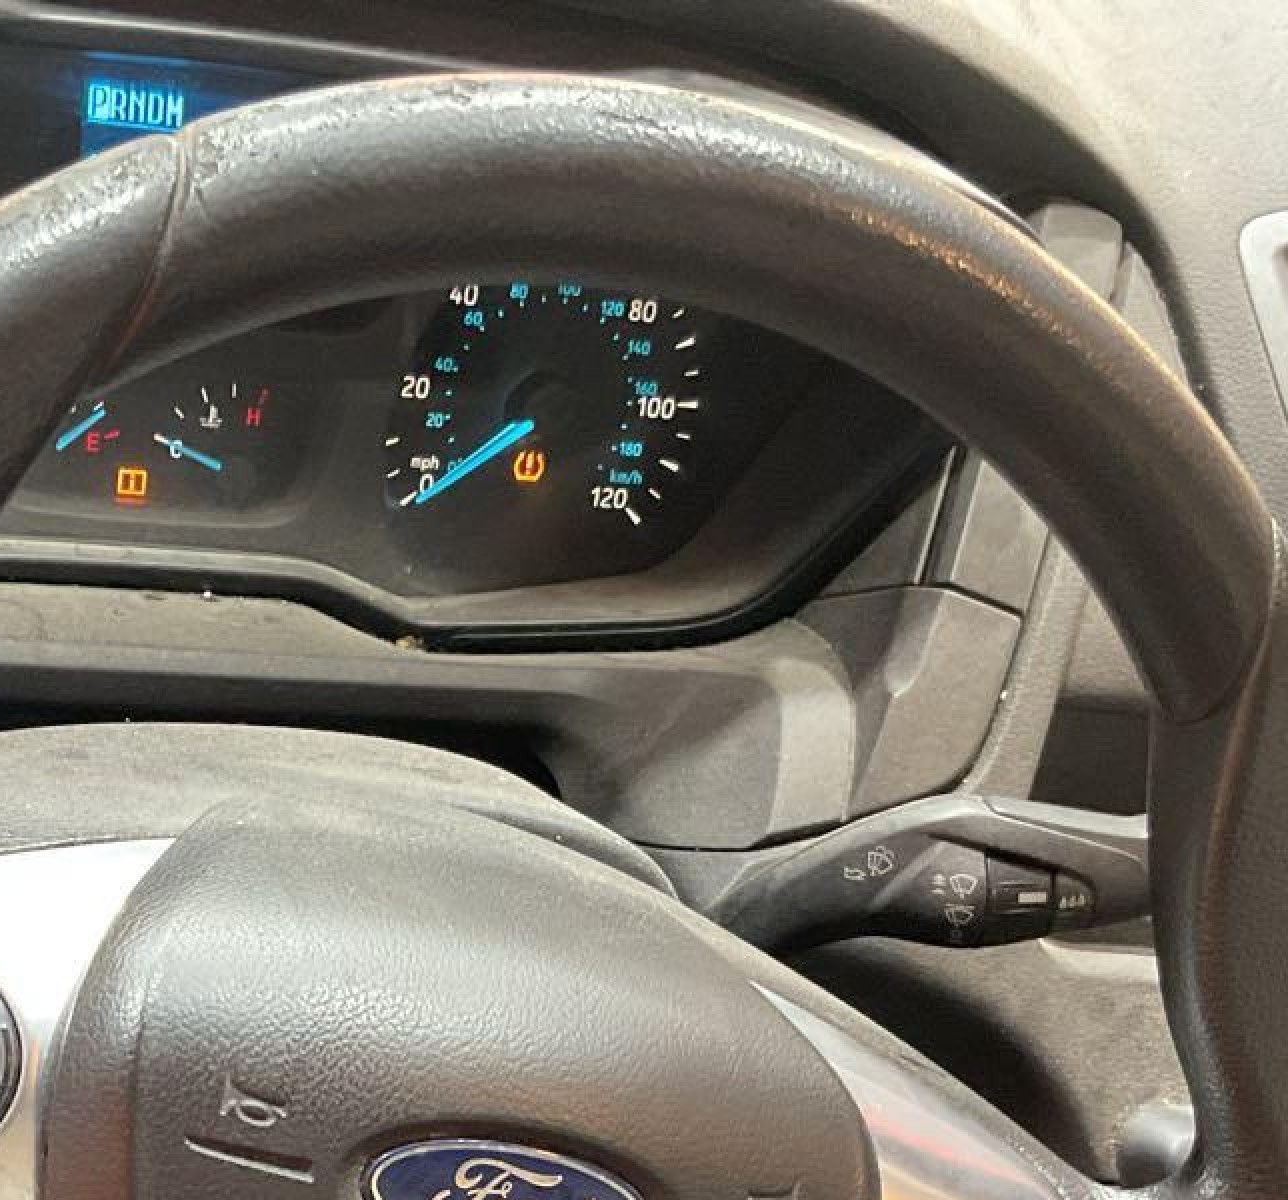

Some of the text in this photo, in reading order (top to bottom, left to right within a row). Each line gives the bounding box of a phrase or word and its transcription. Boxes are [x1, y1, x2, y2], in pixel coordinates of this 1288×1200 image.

[449, 283, 479, 307] 40
[601, 300, 625, 317] 120
[628, 299, 657, 323] 80
[463, 310, 483, 327] 60
[627, 339, 651, 356] 140
[434, 357, 454, 372] 40
[400, 375, 431, 399] 20
[246, 407, 261, 427] H
[637, 396, 675, 420] 100
[425, 413, 444, 429] 20
[86, 431, 100, 452] E
[169, 440, 183, 459] C
[410, 454, 439, 471] mph
[609, 468, 643, 486] km/h
[591, 486, 628, 510] 120
